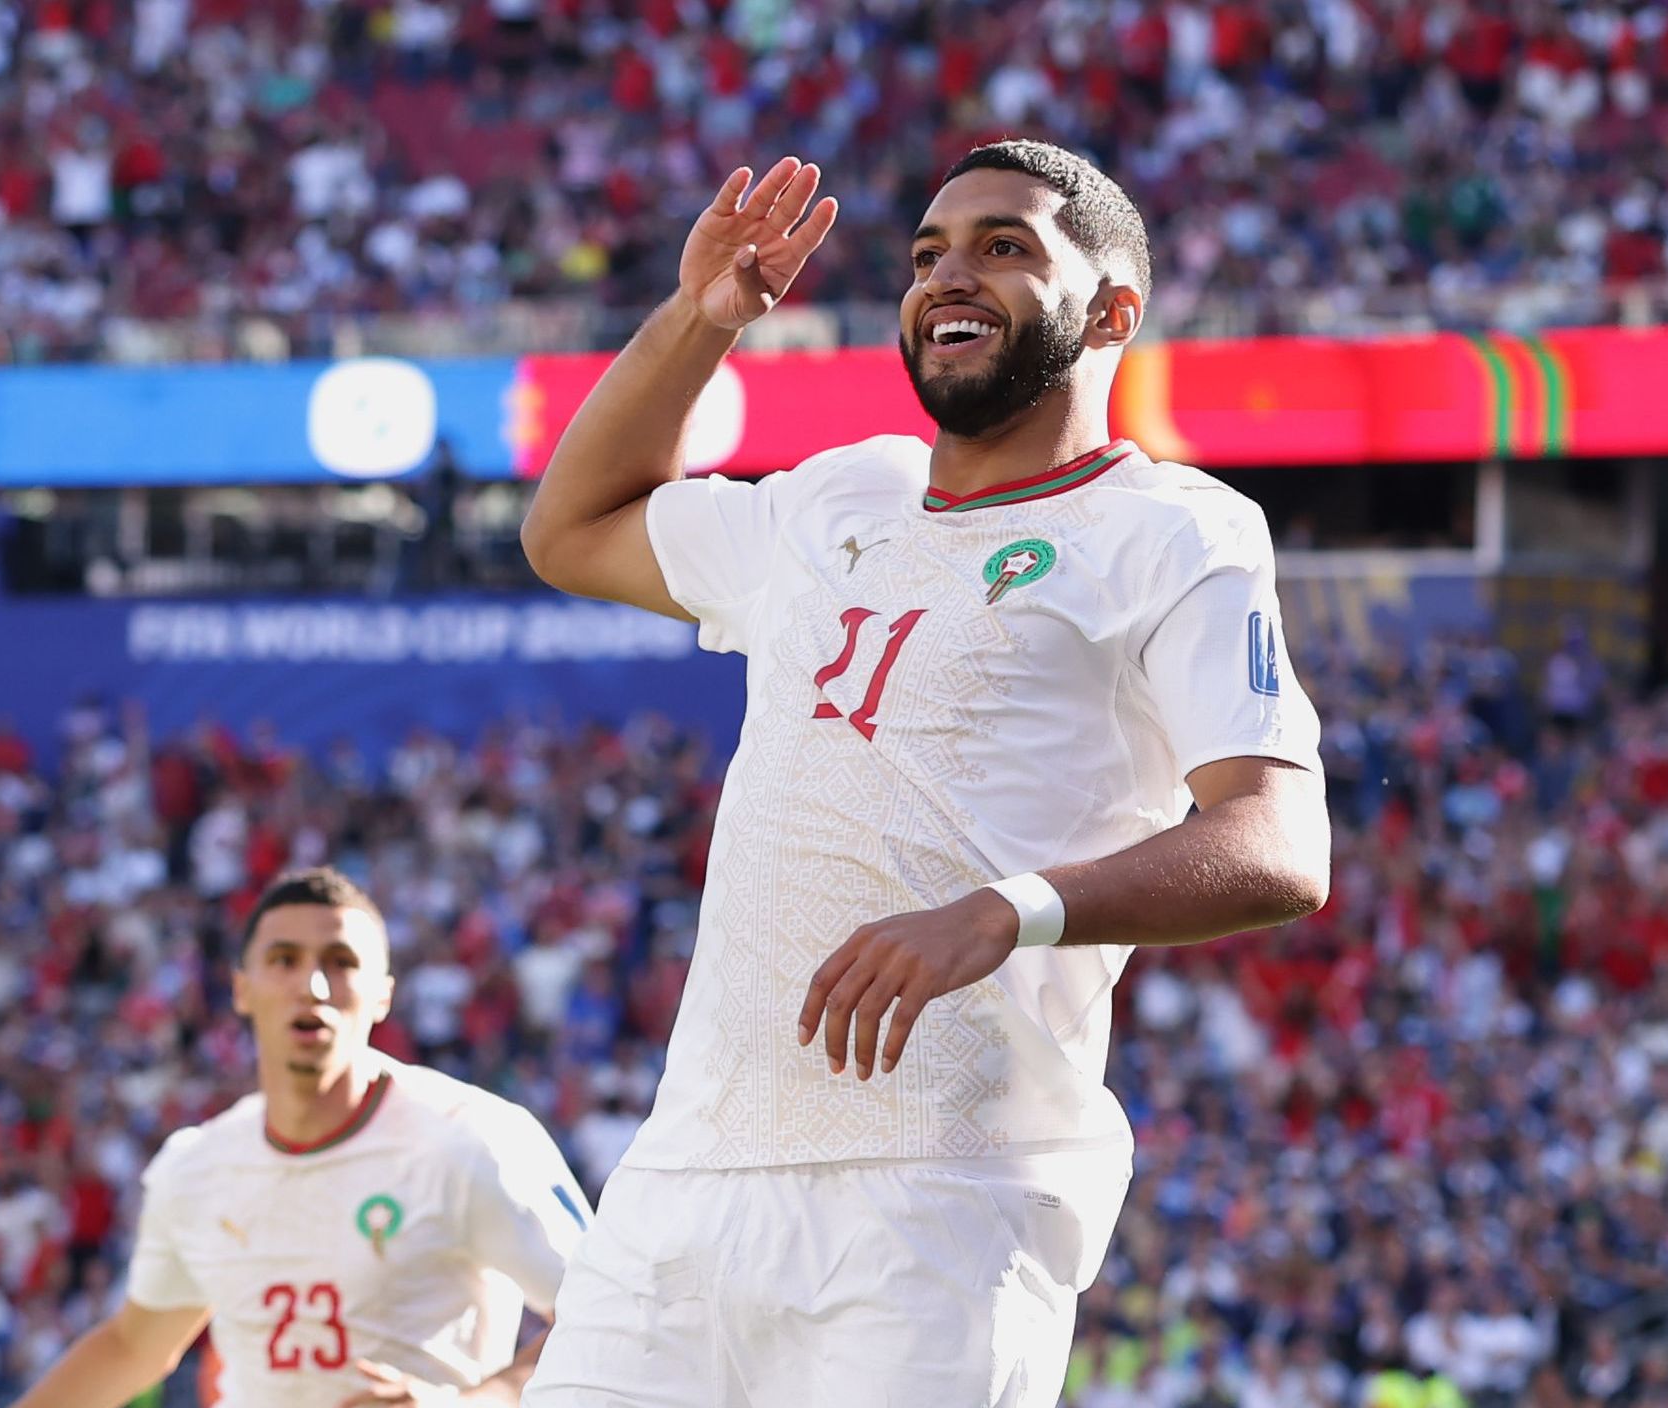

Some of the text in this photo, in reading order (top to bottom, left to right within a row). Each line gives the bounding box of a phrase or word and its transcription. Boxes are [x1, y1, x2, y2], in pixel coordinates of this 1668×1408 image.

[128, 604, 229, 661] FIFA
[241, 604, 407, 661] WORLD
[419, 604, 513, 661] CUP
[812, 607, 928, 742] 11
[263, 1283, 348, 1371] 23
